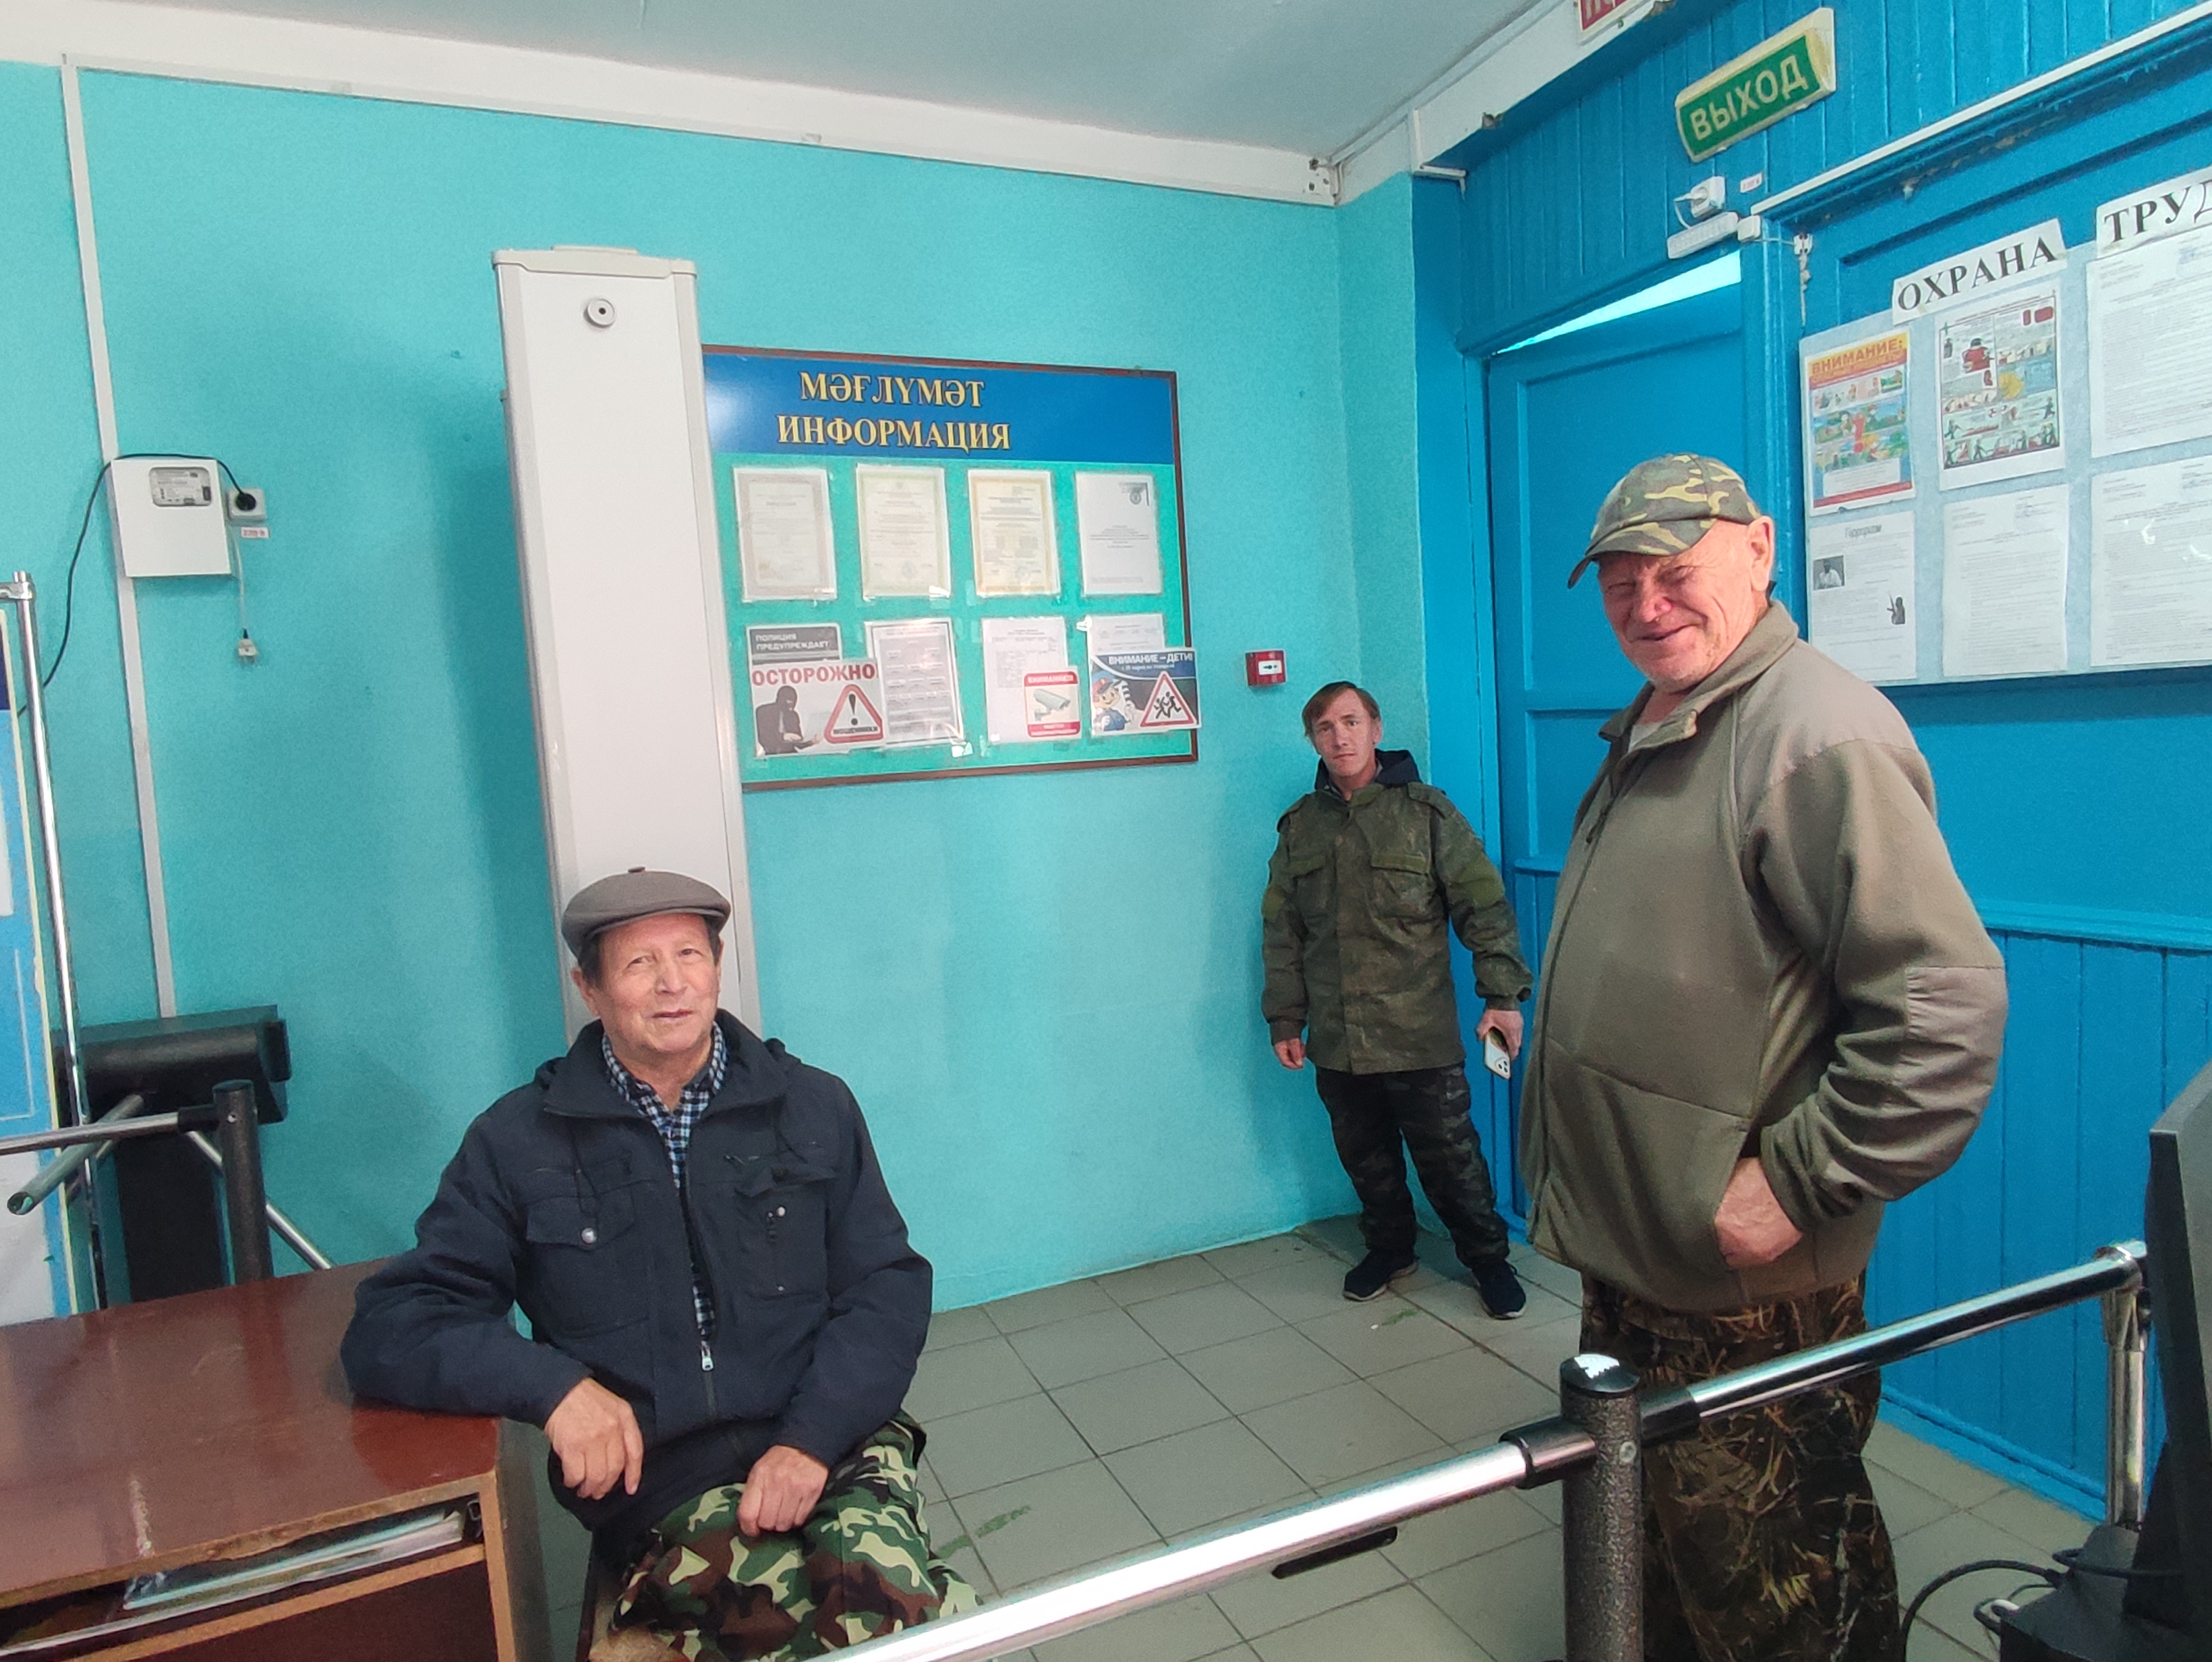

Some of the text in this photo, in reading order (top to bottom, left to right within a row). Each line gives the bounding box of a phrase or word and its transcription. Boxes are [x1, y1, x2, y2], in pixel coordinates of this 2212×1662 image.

[1689, 55, 1809, 141] ВЫХОД
[1897, 236, 2058, 311] ОХРАНА
[777, 415, 1010, 455] ИНФОРМАЦИЯ
[752, 664, 875, 686] ОСТОРОЖНО
[1108, 654, 1159, 665] ВНИМАНИЕ
